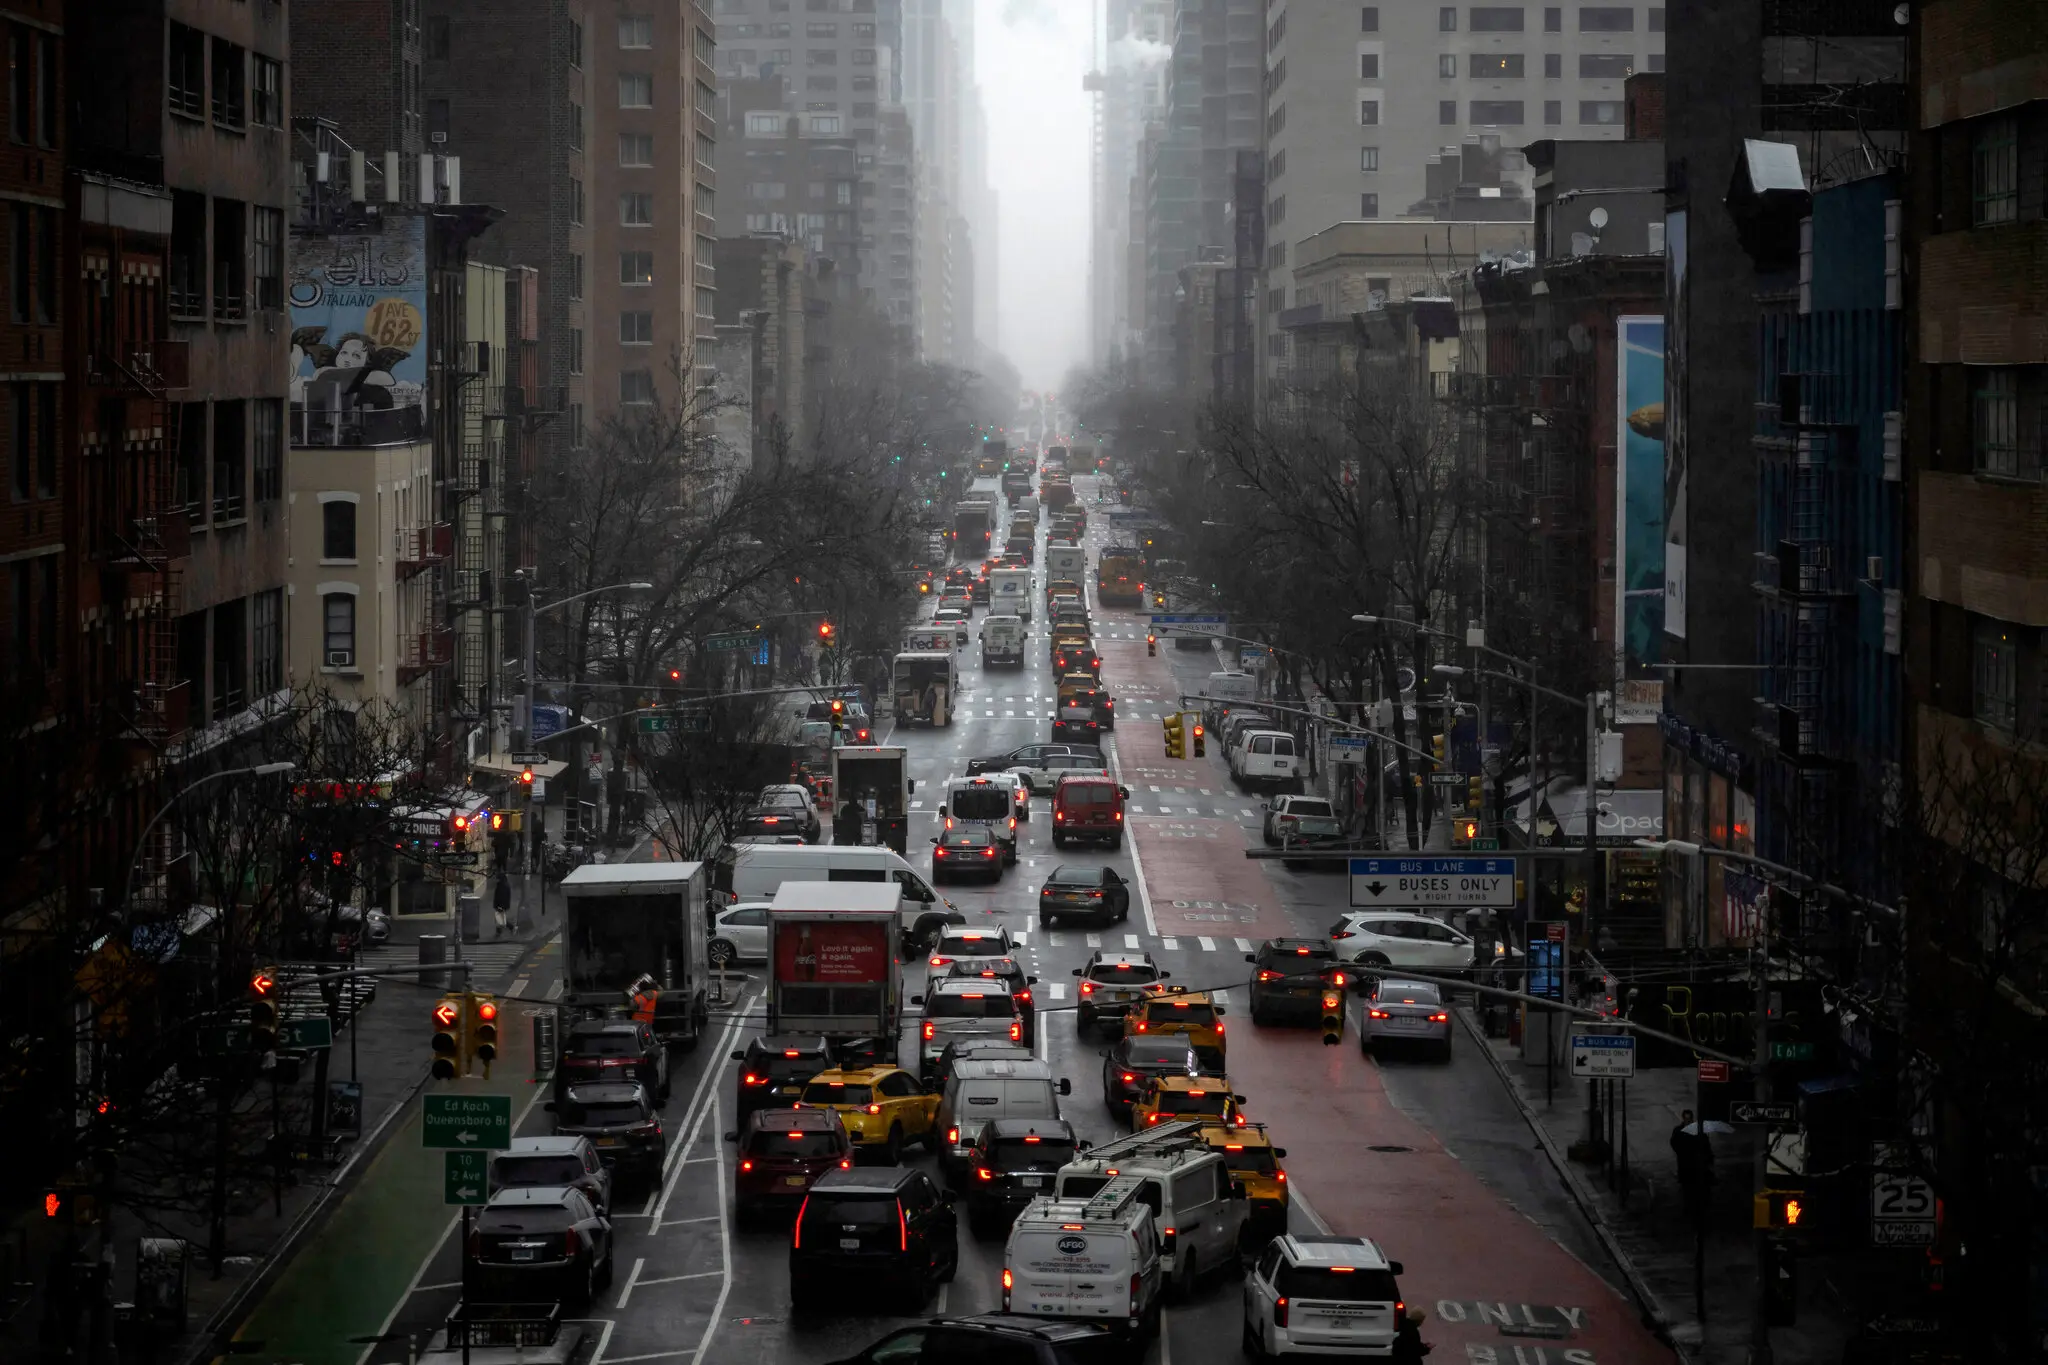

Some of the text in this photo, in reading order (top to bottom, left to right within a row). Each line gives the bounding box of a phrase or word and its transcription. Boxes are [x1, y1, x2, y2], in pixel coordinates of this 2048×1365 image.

[320, 293, 375, 308] ITALIANO
[386, 303, 409, 318] AVE
[380, 319, 412, 346] 62
[910, 636, 952, 650] FedEx
[412, 823, 442, 835] DINER
[1400, 861, 1465, 872] BUS LANE
[1400, 878, 1500, 891] BUSES ONLY
[1425, 893, 1452, 901] RIGHT
[1457, 893, 1487, 901] TURNS
[821, 945, 841, 953] Love
[850, 944, 873, 953] again
[444, 1099, 491, 1112] Ed Koch
[426, 1113, 508, 1127] Queensboro Br
[460, 1154, 473, 1166] TO
[451, 1170, 481, 1181] 2 Ave
[1881, 1185, 1929, 1213] 25
[1888, 1223, 1921, 1233] PHOTO
[1060, 1241, 1085, 1249] AFGO
[1436, 1300, 1581, 1329] ONLY
[1465, 1343, 1597, 1365] BUS
